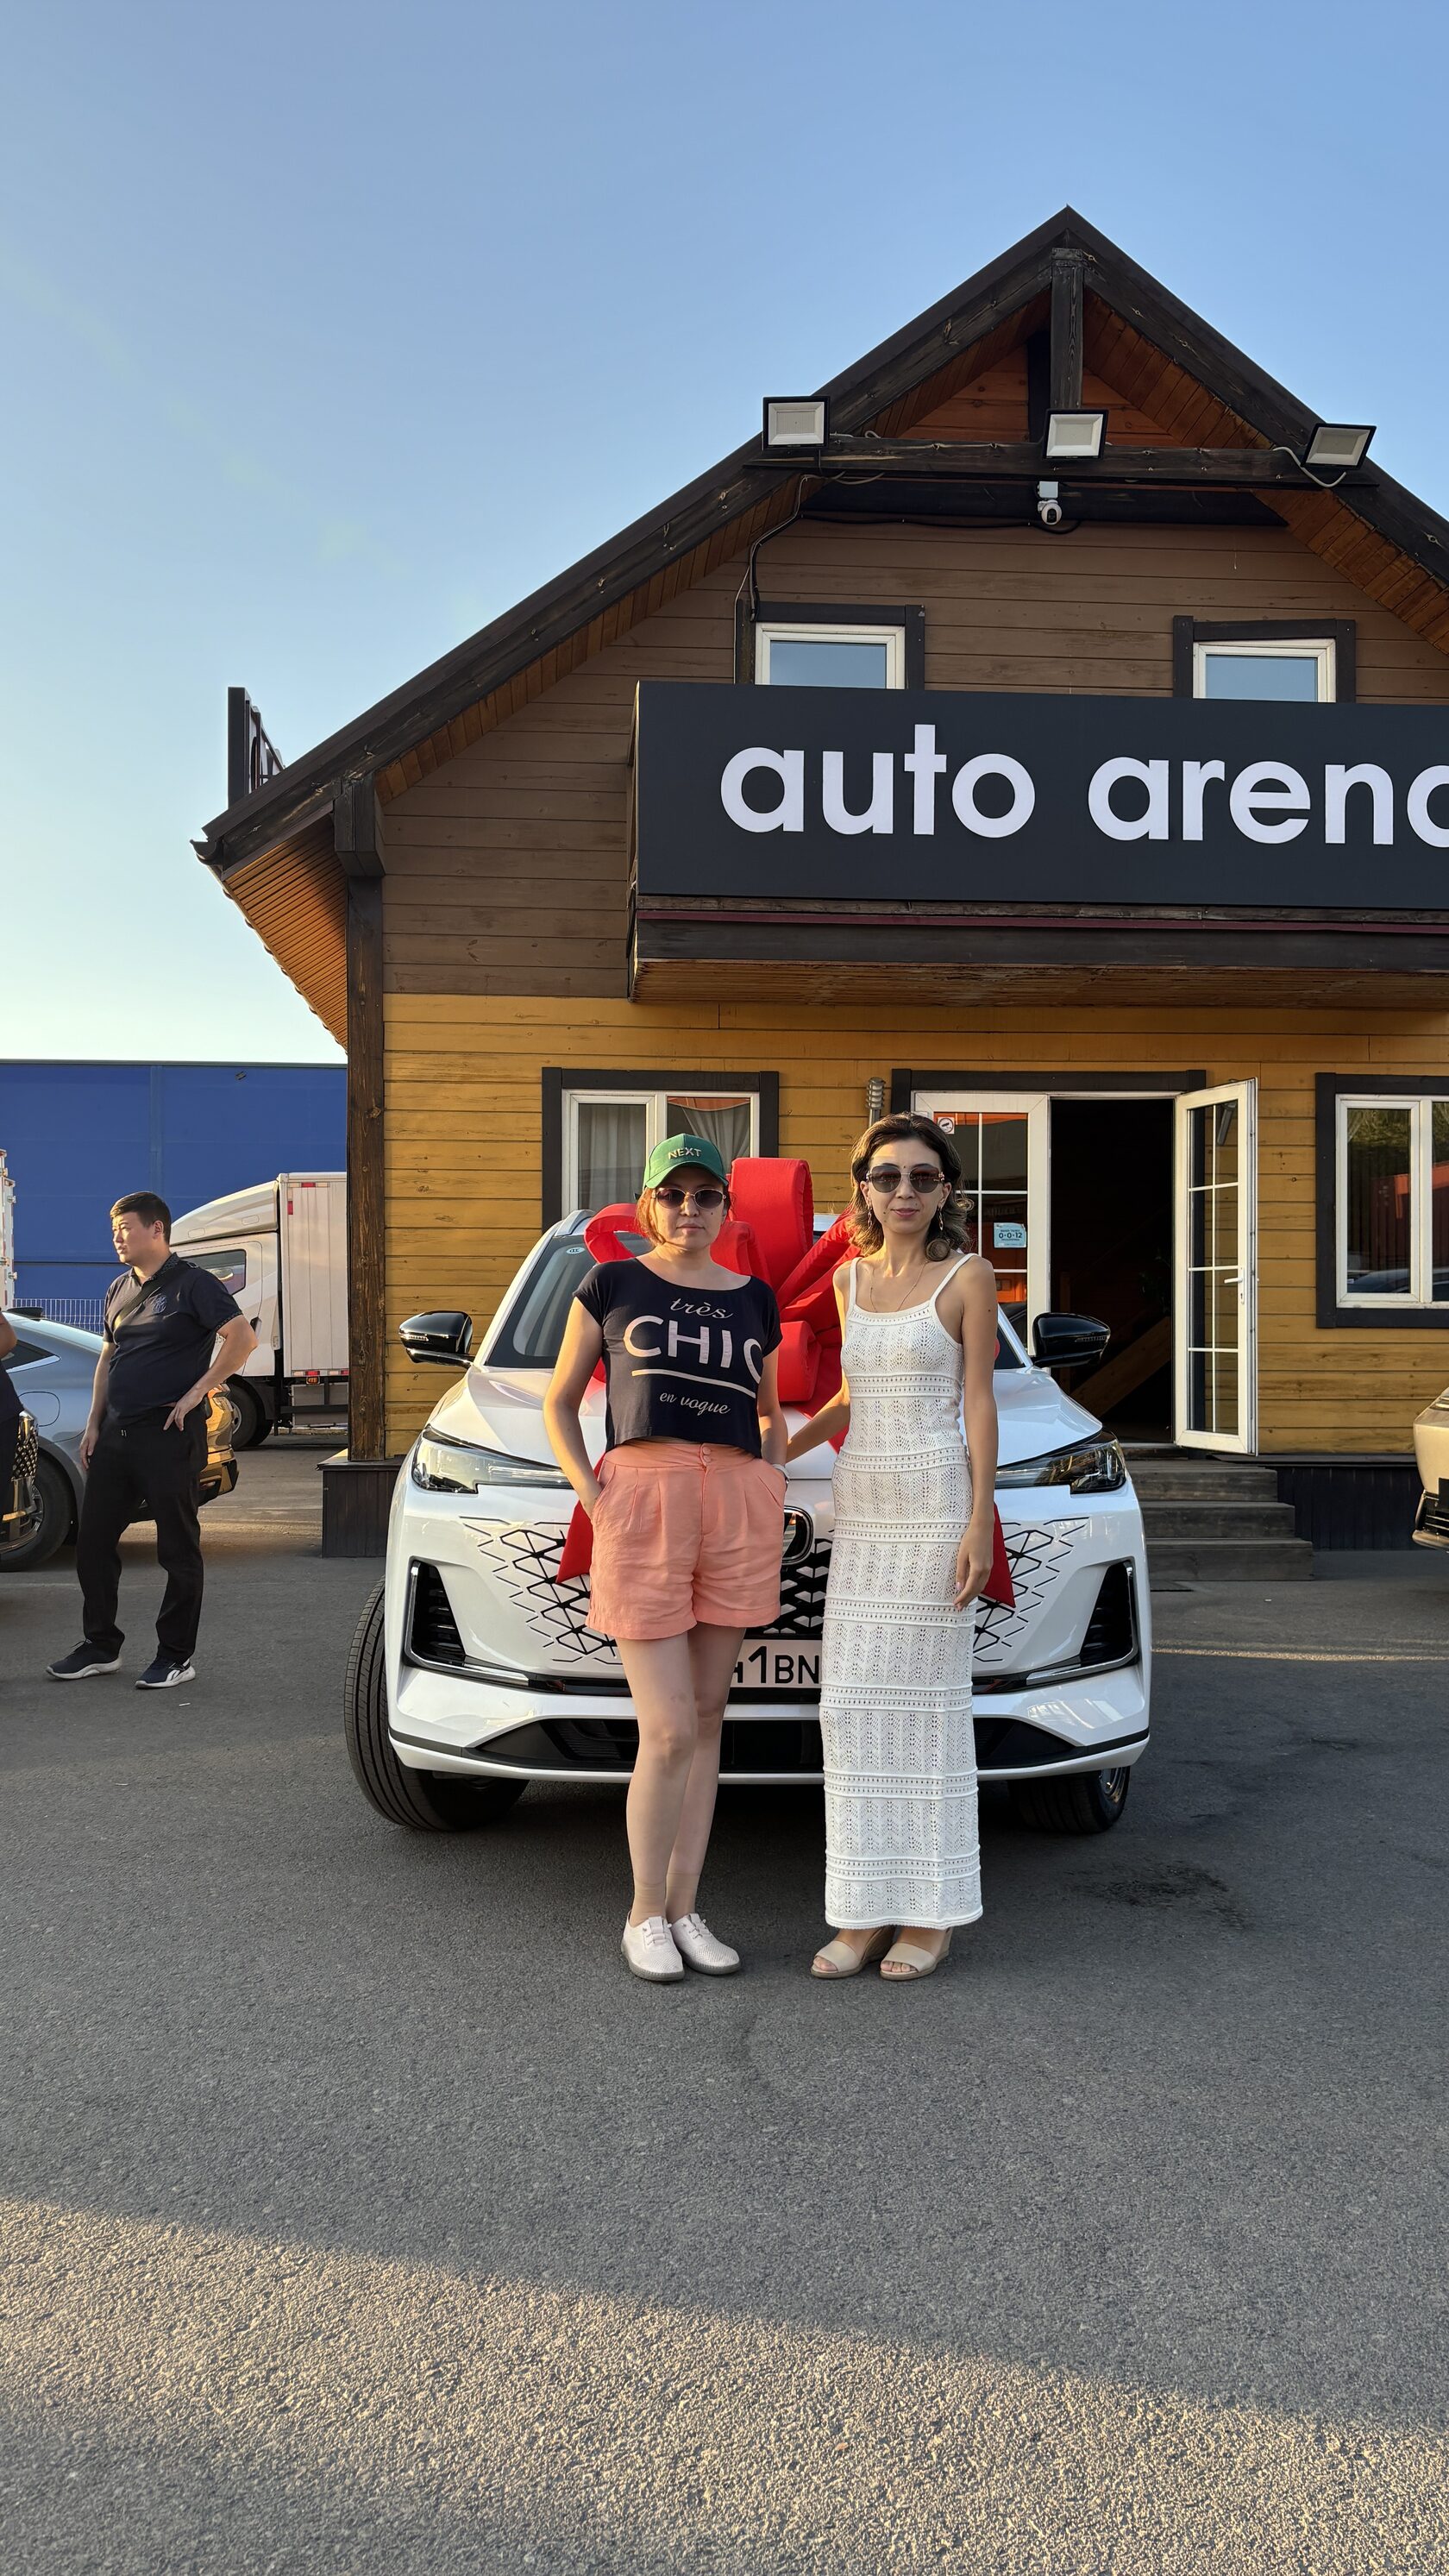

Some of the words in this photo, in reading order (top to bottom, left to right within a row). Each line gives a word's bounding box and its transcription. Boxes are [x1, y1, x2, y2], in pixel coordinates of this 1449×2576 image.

[720, 724, 1036, 839] auto
[668, 1147, 702, 1160] NEXT
[669, 1297, 734, 1320] très
[659, 1392, 677, 1404] en
[680, 1396, 731, 1417] vogue
